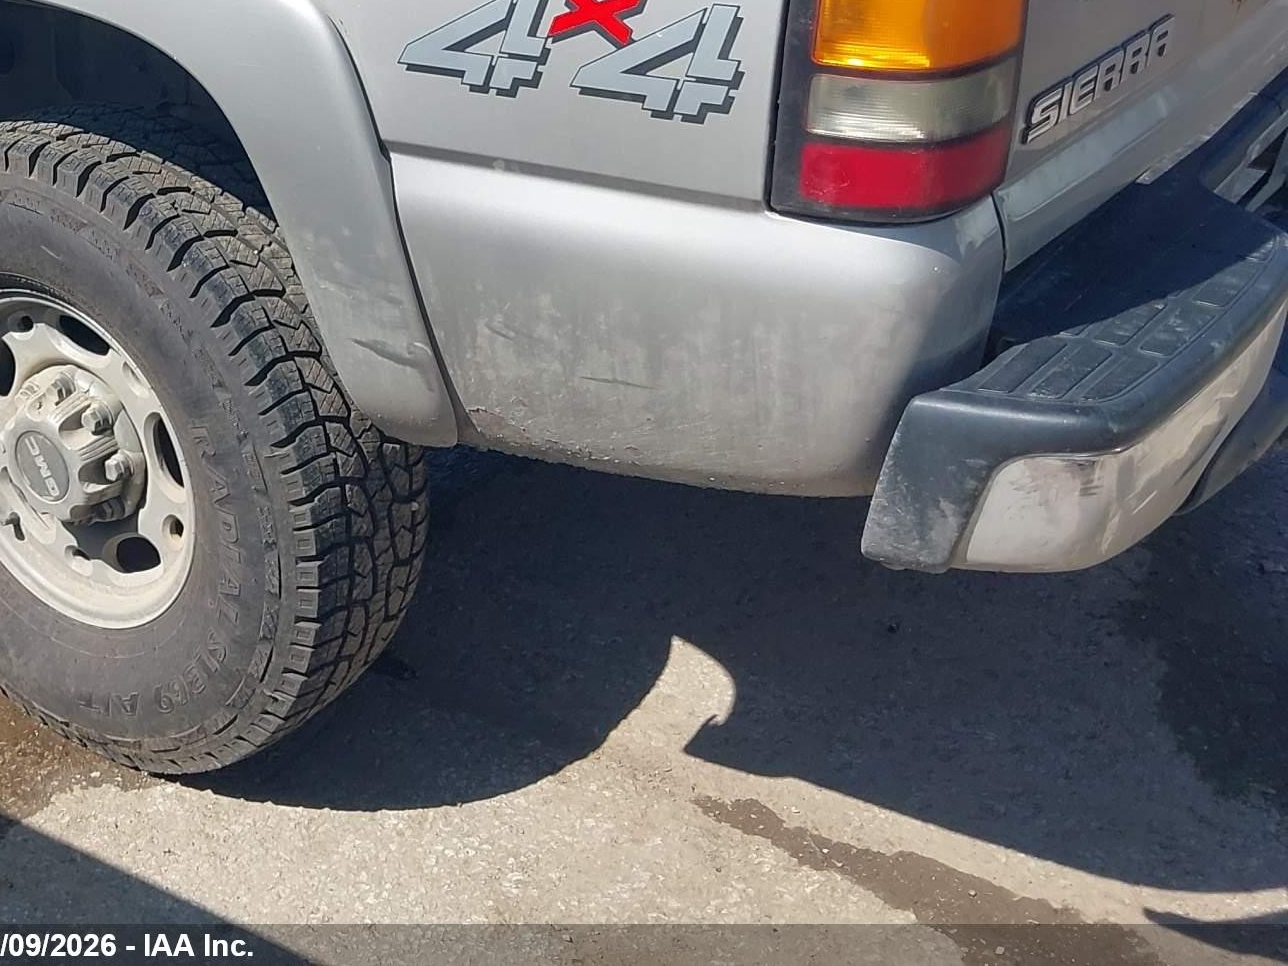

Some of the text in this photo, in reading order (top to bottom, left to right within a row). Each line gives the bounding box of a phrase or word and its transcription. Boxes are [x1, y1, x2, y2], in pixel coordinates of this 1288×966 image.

[1021, 13, 1176, 145] SIERRA
[24, 435, 61, 497] GMC
[190, 425, 242, 626] RADIAL
[78, 690, 140, 717] A/T
